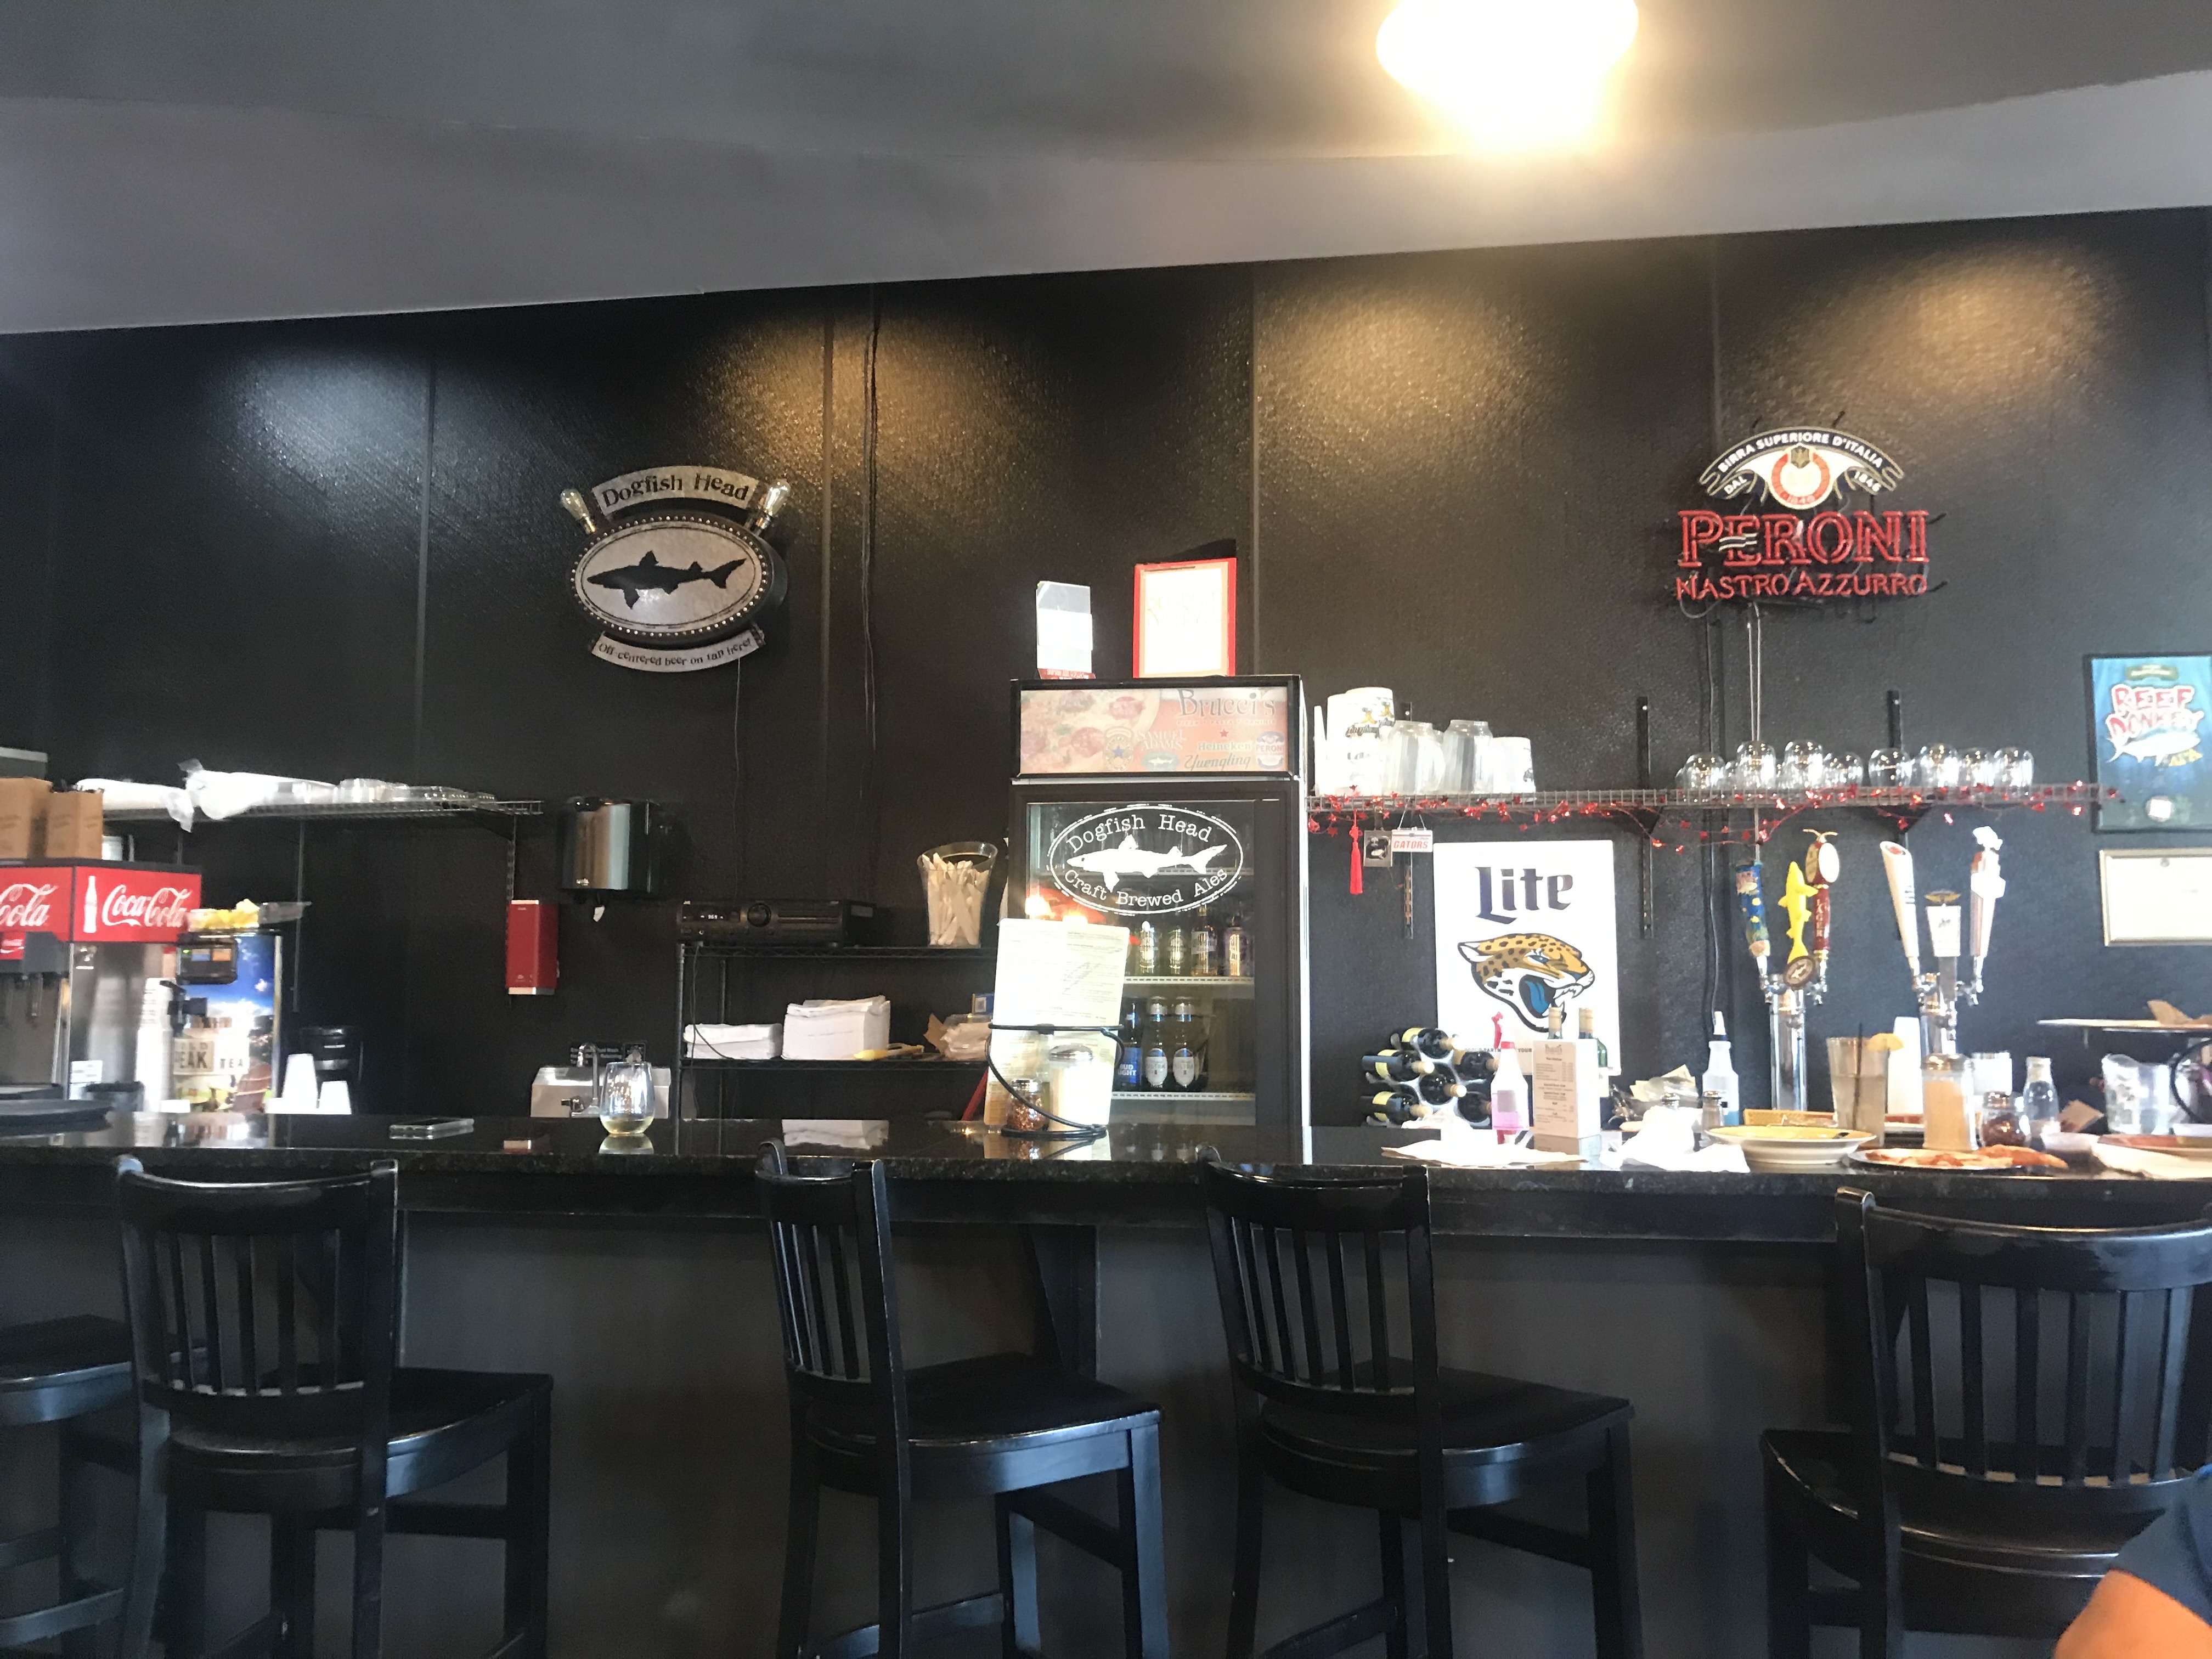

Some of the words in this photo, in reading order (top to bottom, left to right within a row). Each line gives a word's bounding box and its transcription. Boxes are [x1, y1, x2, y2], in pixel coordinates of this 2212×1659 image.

[1718, 444, 1756, 473] BIRRA
[1756, 432, 1830, 450] SUPERIORE
[1832, 436, 1884, 469] D'ITALIA
[602, 475, 683, 508] Dogfish
[693, 473, 750, 501] Head
[1723, 476, 1748, 495] DAL
[1853, 471, 1882, 493] 1846
[1677, 510, 1931, 567] PERONI
[1675, 571, 1790, 600] NASTRO
[1795, 571, 1928, 596] AZZURRO
[664, 657, 687, 666] beer
[707, 650, 725, 660] tap
[2114, 687, 2192, 709] REEF
[1198, 741, 1251, 751] Heineken
[1184, 752, 1252, 772] Yuengling
[1066, 814, 1146, 853] Dogfish
[1158, 814, 1212, 843] Head
[1393, 840, 1429, 849] GATORS
[1064, 869, 1108, 901] Craft
[1115, 889, 1184, 907] Brewed
[1193, 868, 1228, 898] Ales
[1474, 866, 1573, 924] Lite
[101, 884, 193, 928] Coca-Cola
[219, 1058, 243, 1068] TEA
